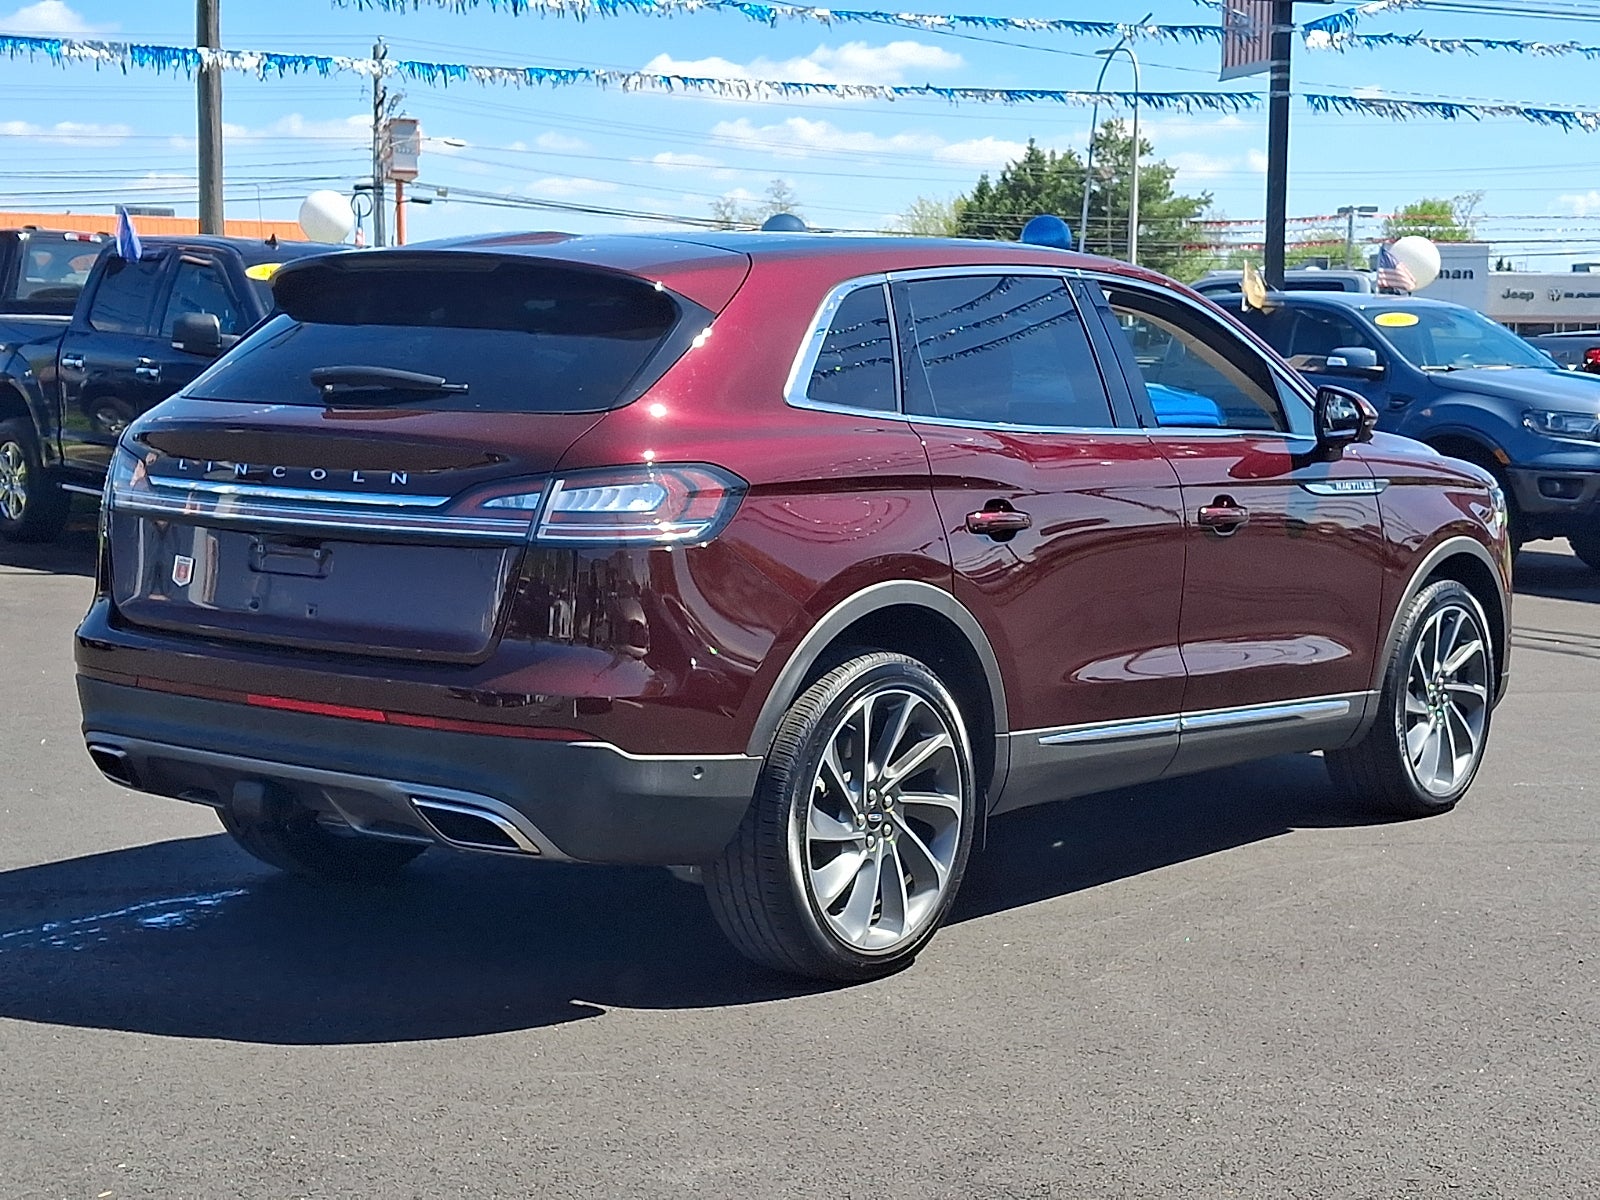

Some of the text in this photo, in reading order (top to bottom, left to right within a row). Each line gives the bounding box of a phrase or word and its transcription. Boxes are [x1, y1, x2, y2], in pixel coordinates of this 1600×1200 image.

[1502, 288, 1535, 301] Jeep
[178, 458, 408, 485] LINCOLN
[1335, 481, 1374, 491] NAUTILUS
